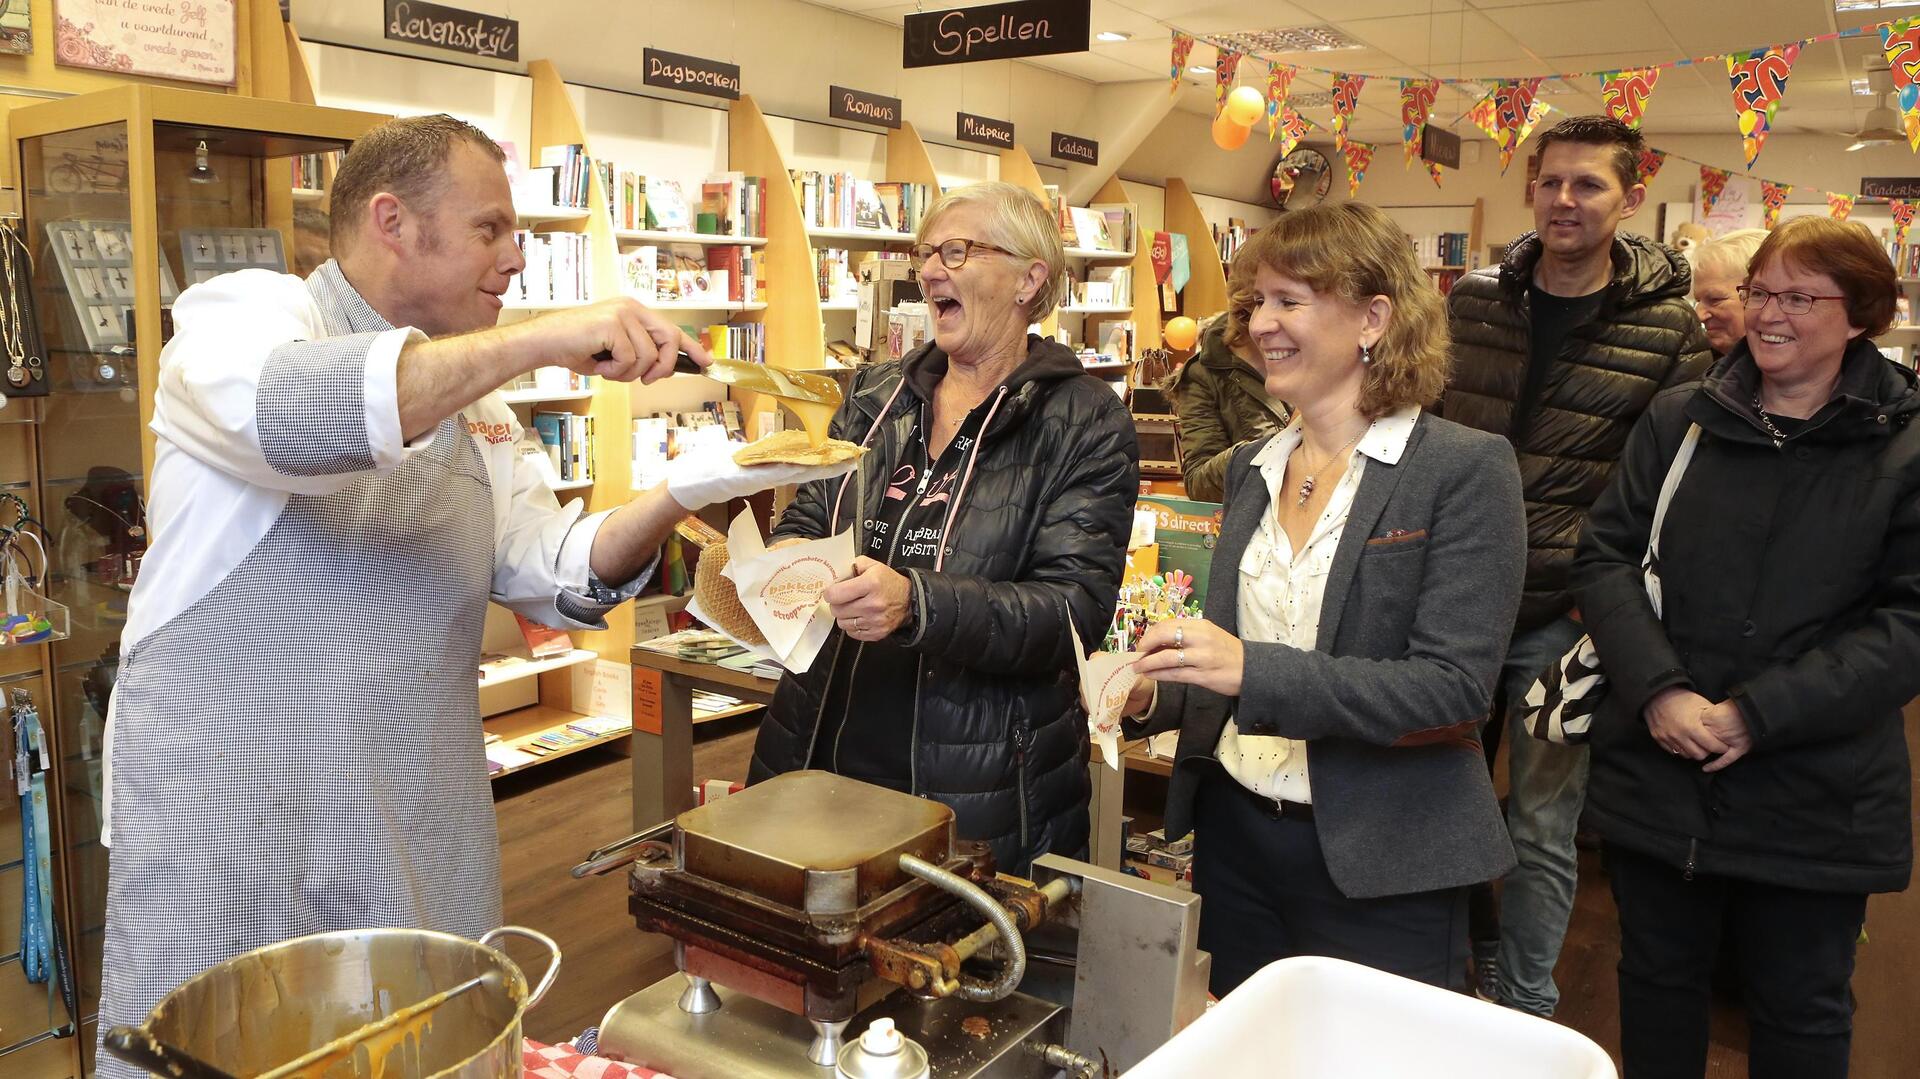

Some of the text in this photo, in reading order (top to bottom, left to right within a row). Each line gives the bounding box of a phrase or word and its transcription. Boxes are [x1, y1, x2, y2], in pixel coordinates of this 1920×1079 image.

[122, 0, 139, 9] de
[142, 3, 176, 17] vrede
[180, 0, 208, 27] Zelf
[134, 22, 208, 41] voortdurend
[933, 11, 1053, 56] Spellen
[143, 42, 178, 56] vrede
[650, 57, 739, 92] Dagboeken
[843, 93, 894, 121] Romans
[1058, 137, 1095, 160] Cadeau
[1346, 147, 1373, 173] 25
[1763, 186, 1787, 209] 25
[1891, 203, 1916, 227] 25
[1170, 513, 1212, 532] direct
[768, 579, 824, 596] bakken
